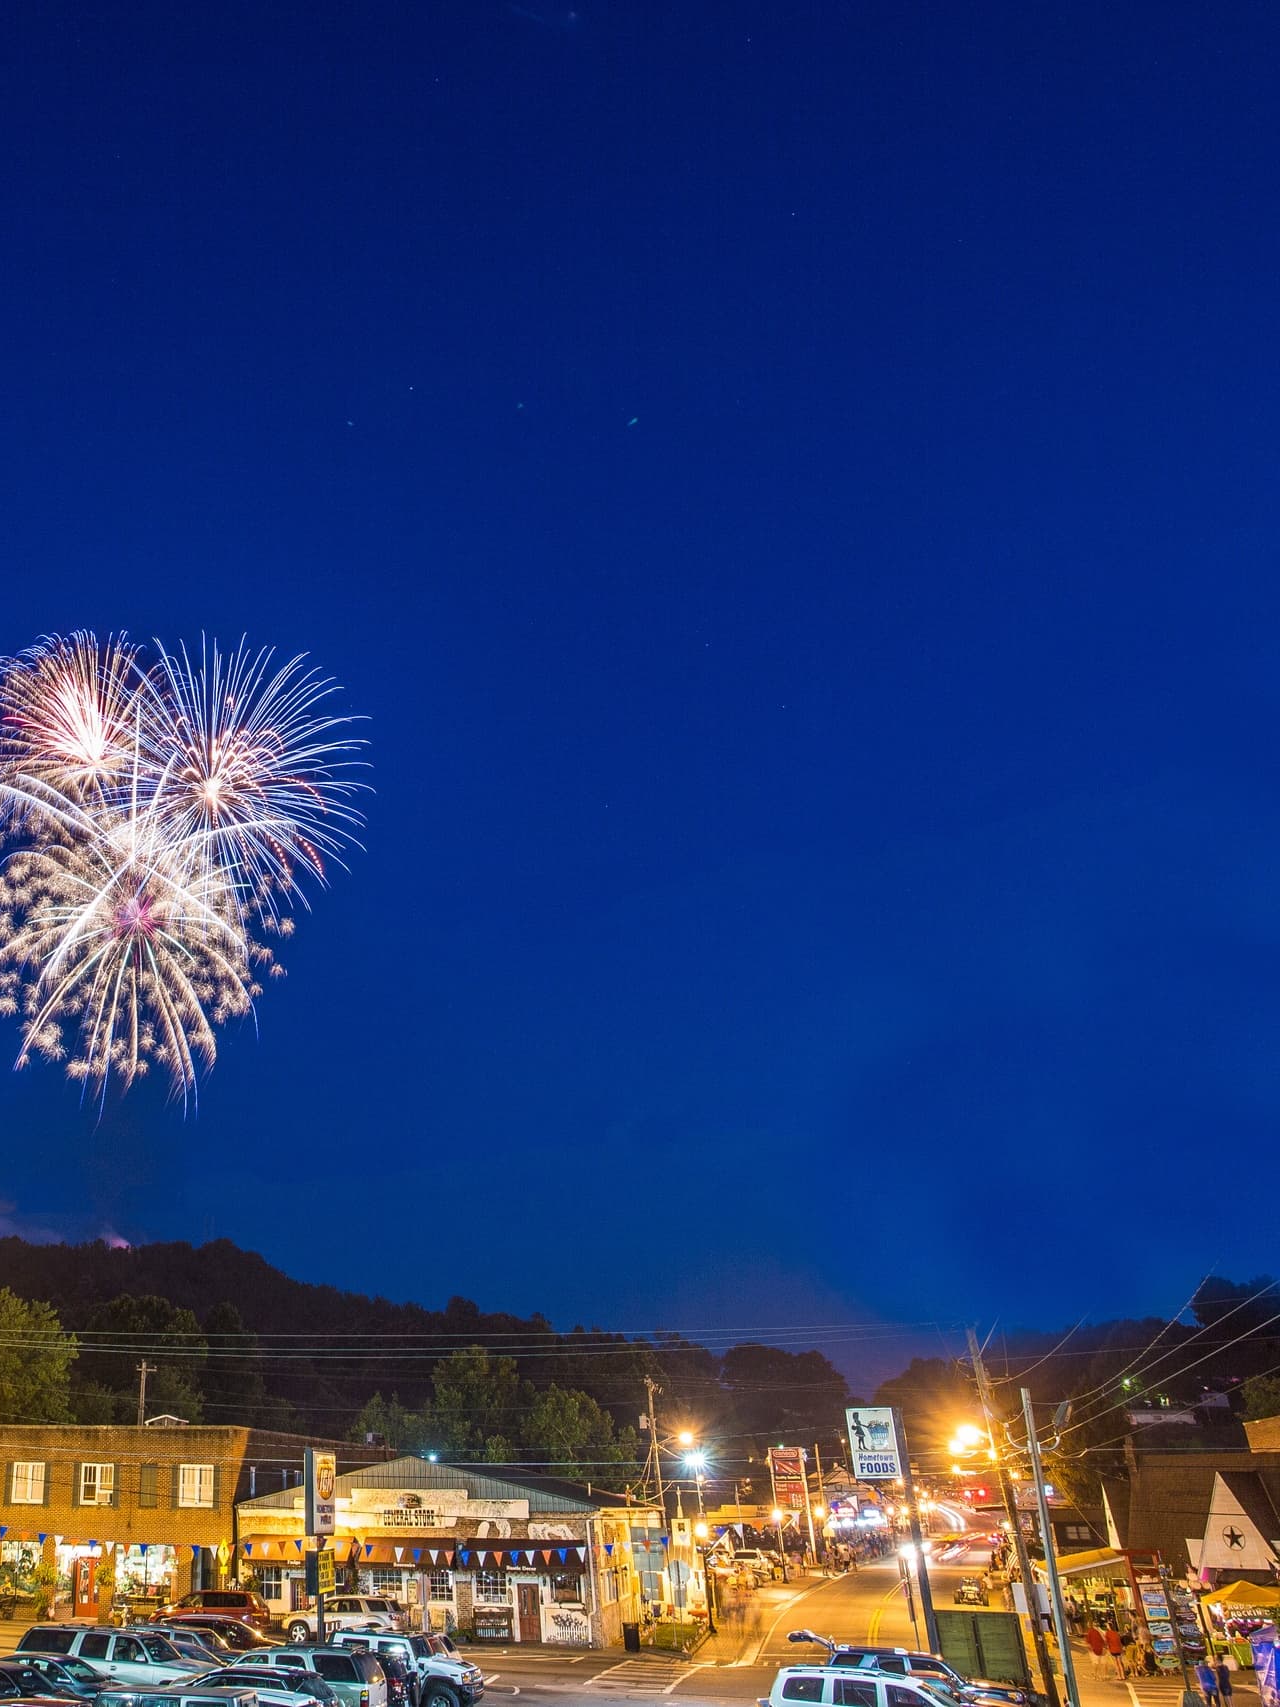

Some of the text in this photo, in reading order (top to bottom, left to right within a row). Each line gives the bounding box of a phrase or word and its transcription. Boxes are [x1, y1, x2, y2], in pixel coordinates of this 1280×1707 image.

[858, 1453, 894, 1461] Hometown
[860, 1462, 896, 1473] FOODS
[383, 1509, 435, 1527] GENERAL STORE
